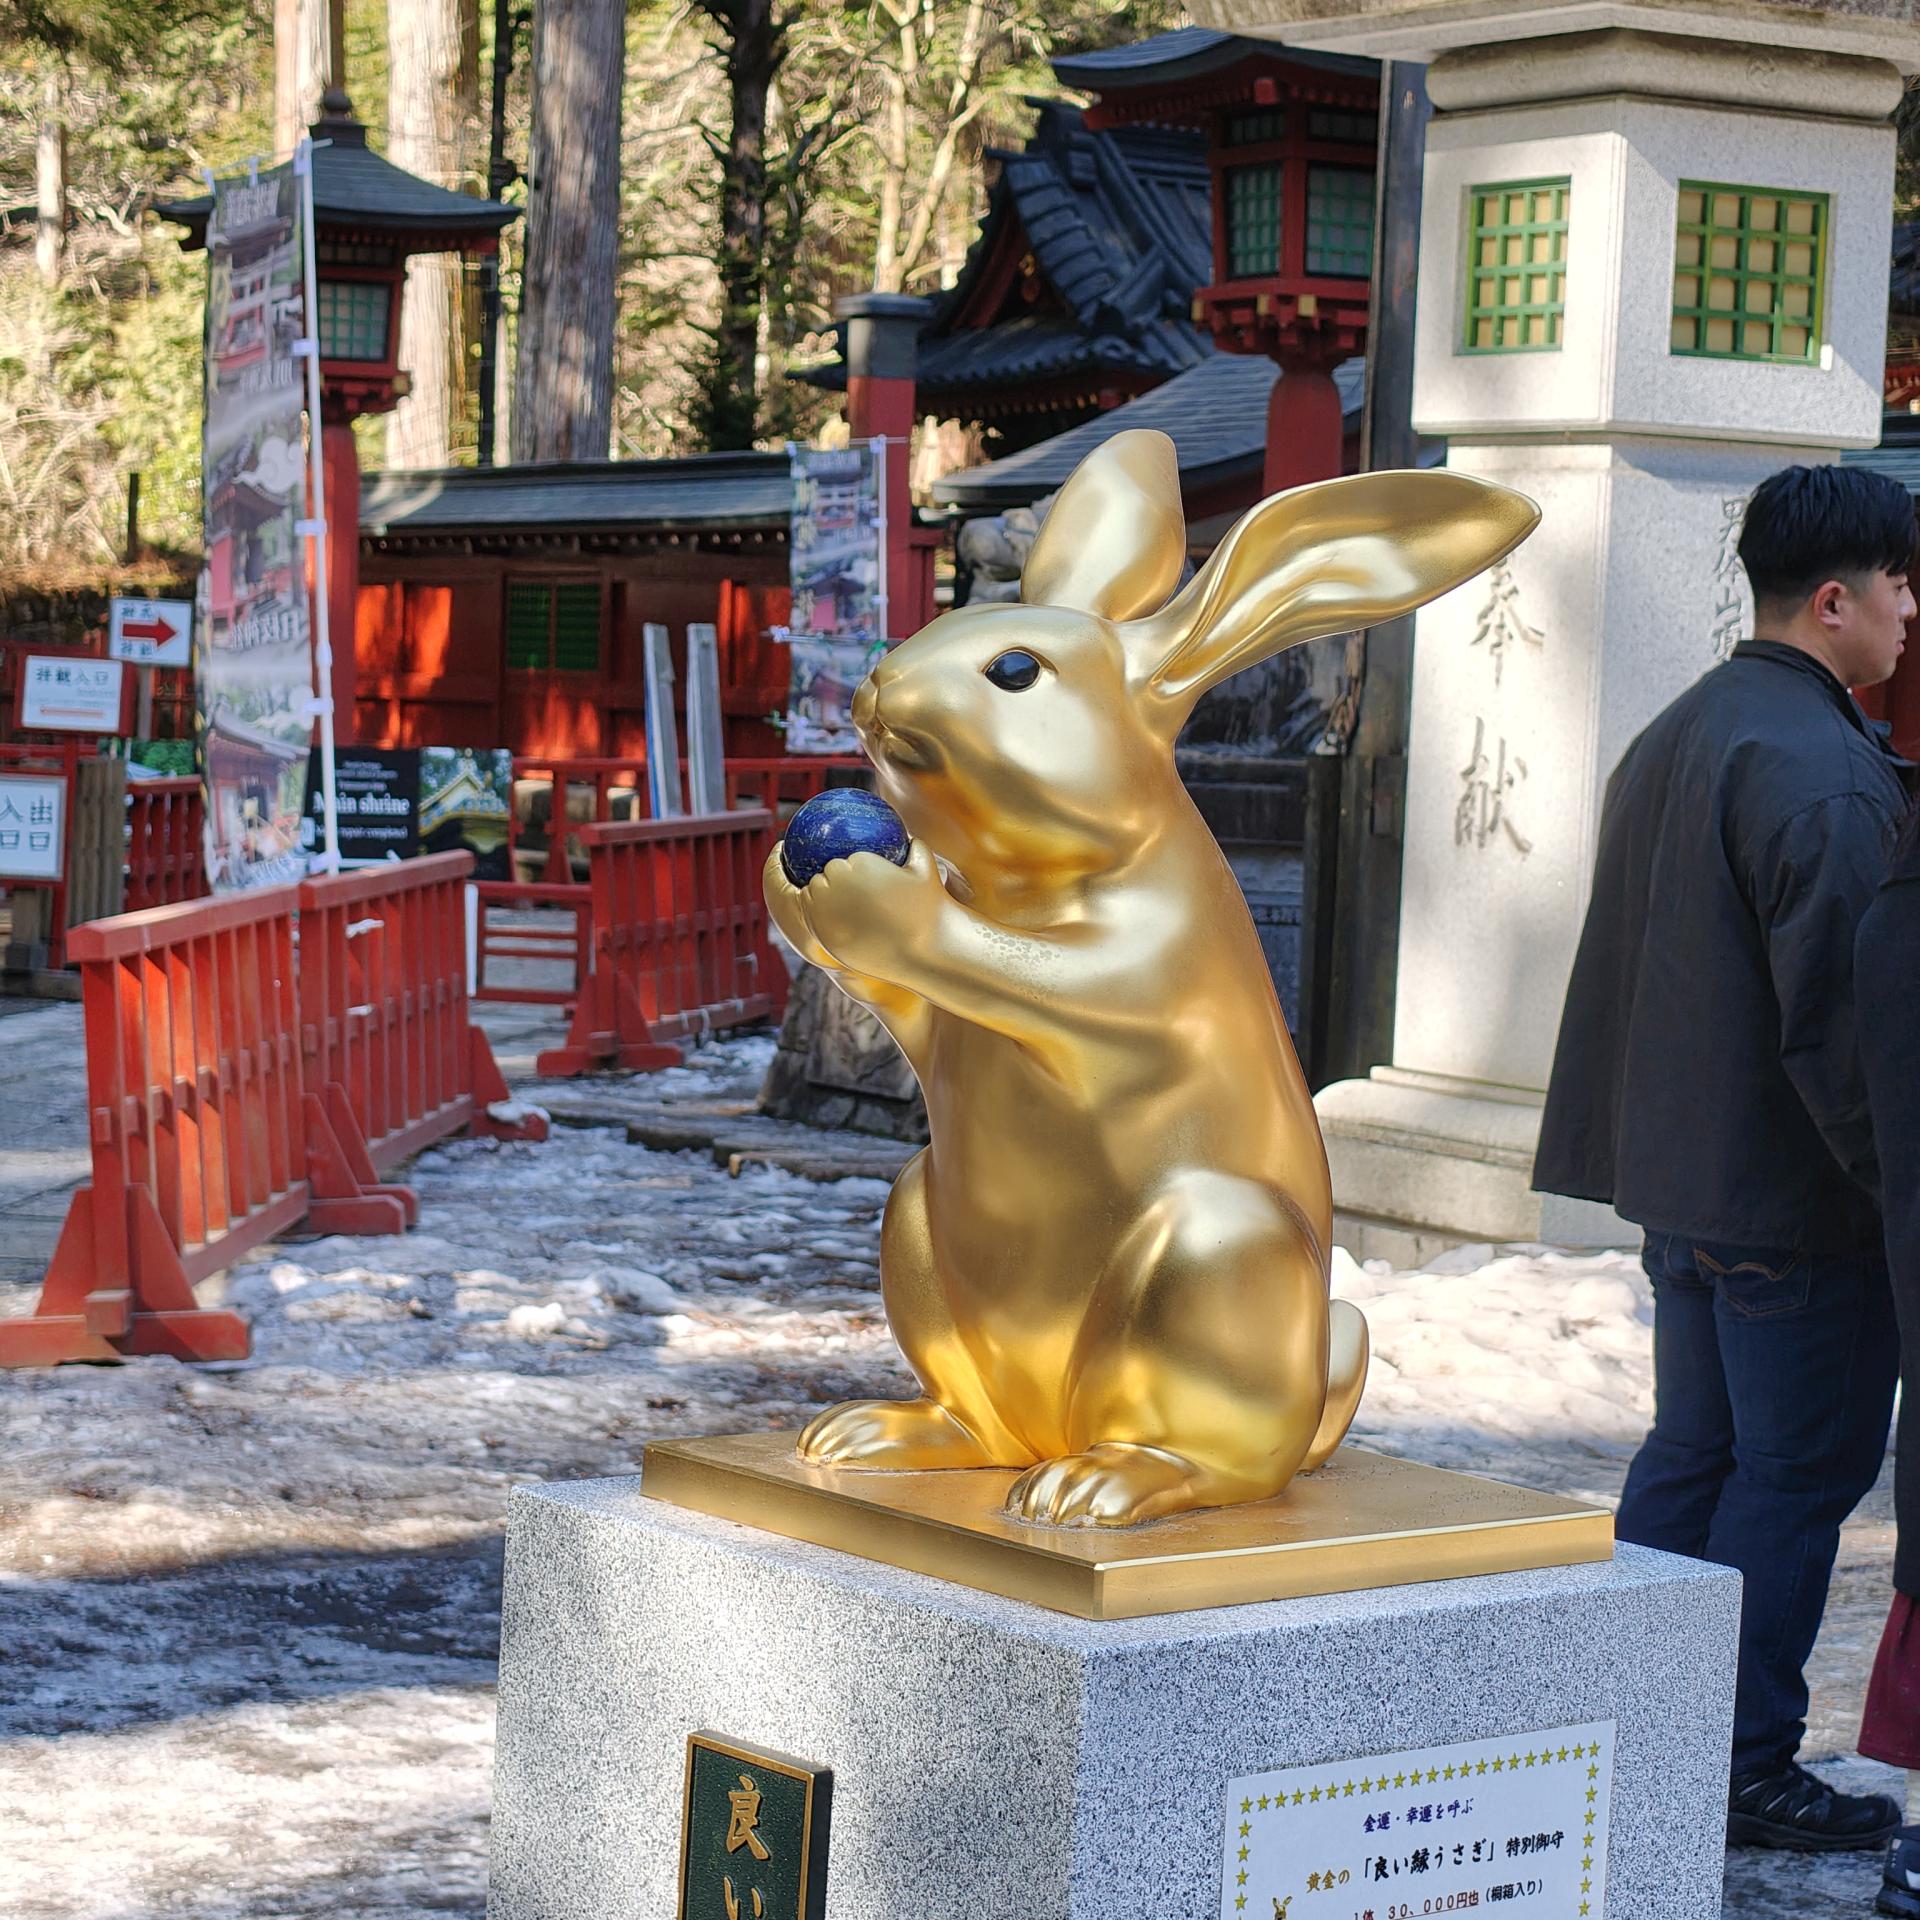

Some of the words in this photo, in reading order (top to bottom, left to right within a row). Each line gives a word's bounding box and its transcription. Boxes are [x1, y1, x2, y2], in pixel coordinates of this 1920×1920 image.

[359, 792, 410, 815] shrine
[1363, 1798, 1474, 1834] 金運・幸運を呼ぶ
[1306, 1869, 1350, 1893] 黄金の
[1364, 1838, 1495, 1882] 「良い縁うさぎ」
[1506, 1830, 1565, 1858] 特別御守
